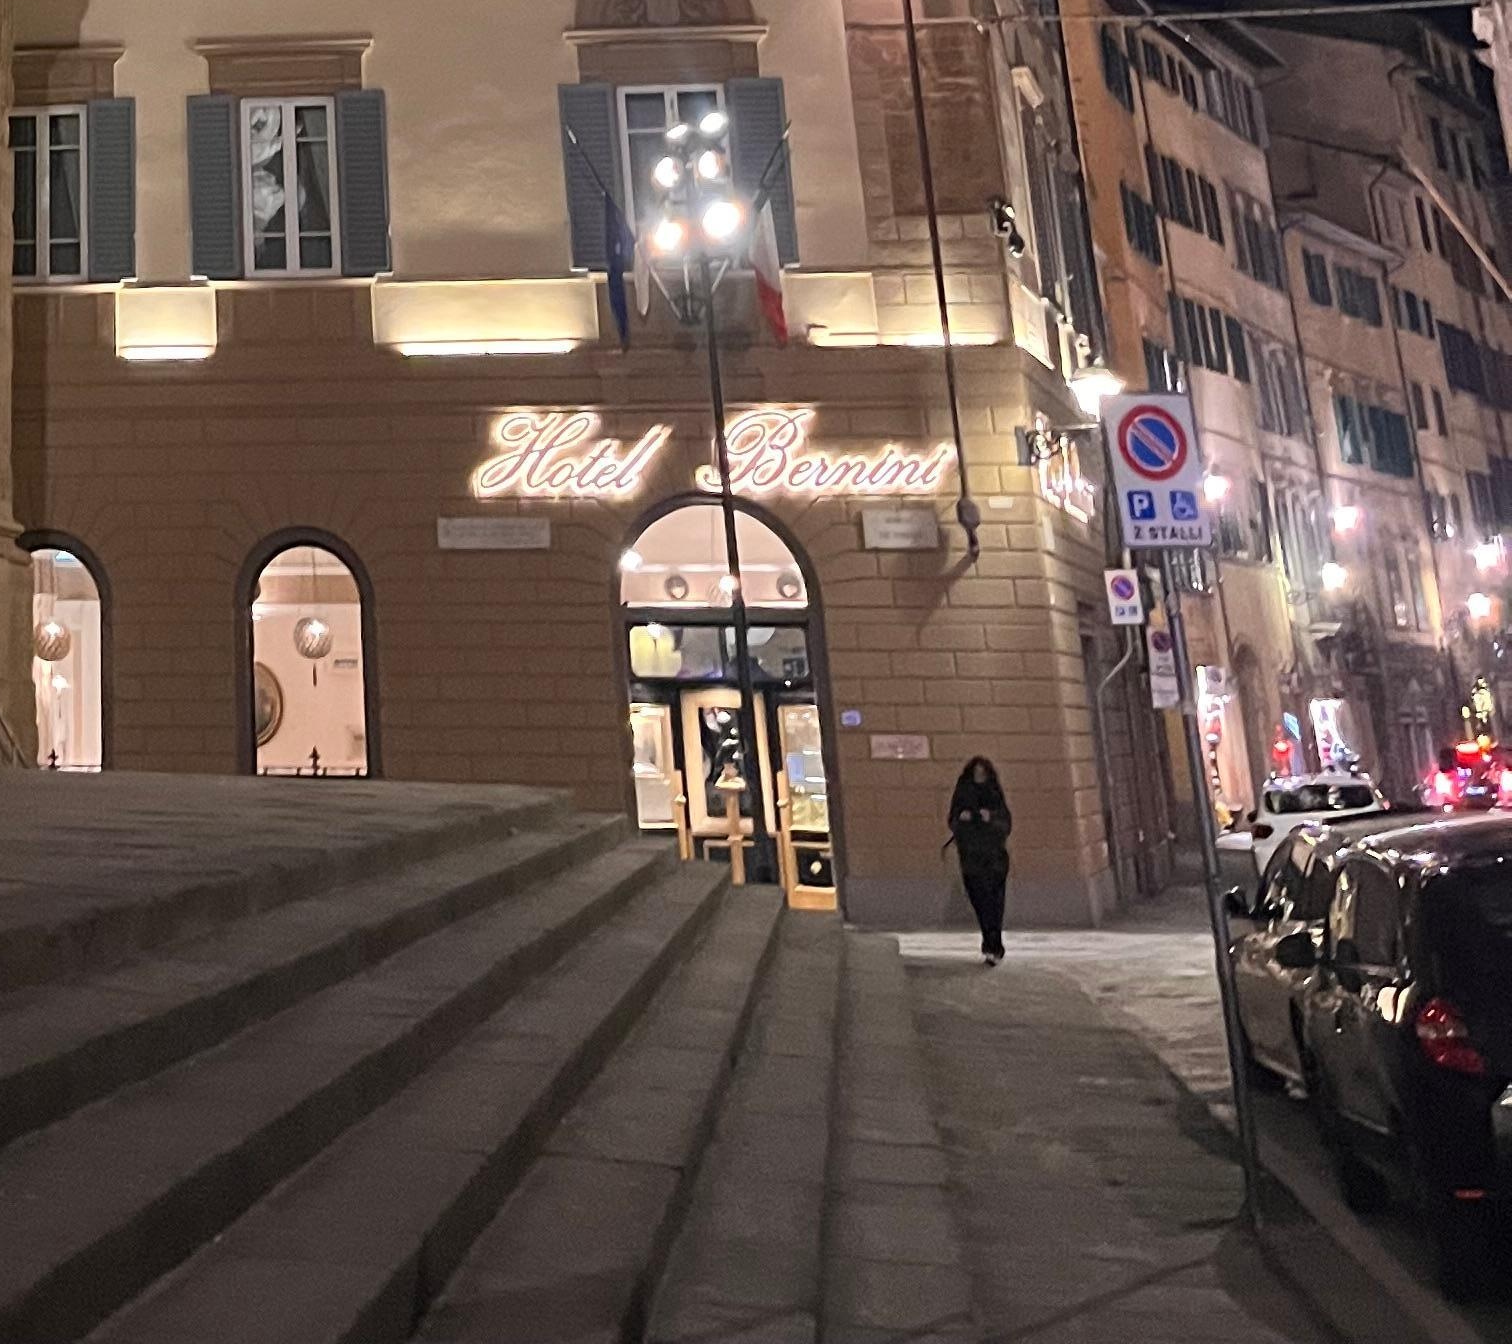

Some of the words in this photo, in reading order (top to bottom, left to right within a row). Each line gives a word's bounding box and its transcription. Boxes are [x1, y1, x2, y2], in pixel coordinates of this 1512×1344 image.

[477, 409, 671, 493] Hotel
[698, 407, 955, 493] Bernini
[1132, 493, 1150, 518] P
[1148, 525, 1203, 541] STALLI
